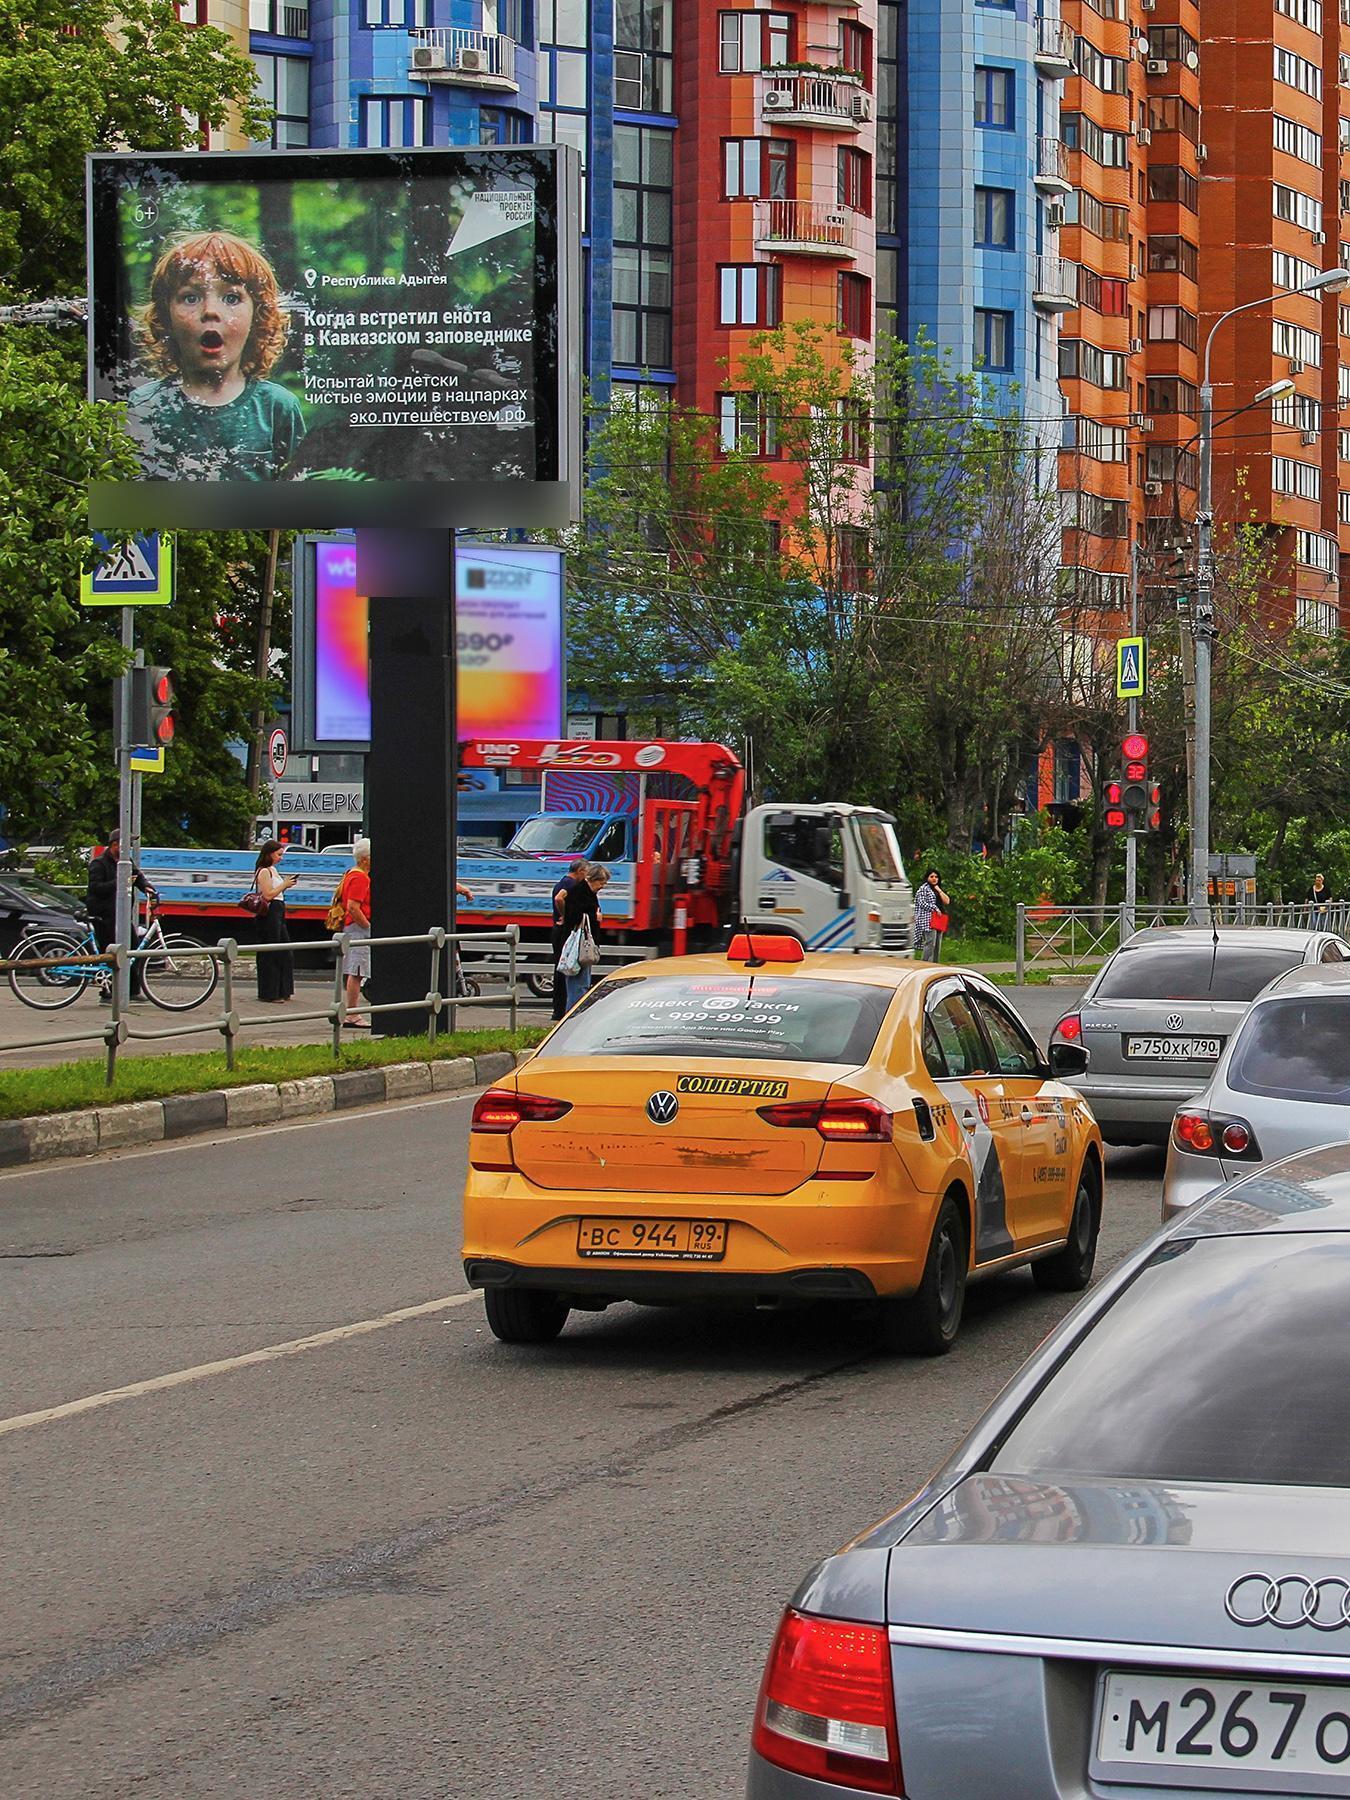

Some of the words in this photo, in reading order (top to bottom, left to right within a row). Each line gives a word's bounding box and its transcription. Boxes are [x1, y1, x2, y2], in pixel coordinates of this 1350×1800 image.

[474, 192, 533, 202] НАЦИОНАЛЬНЫЕ
[135, 204, 155, 222] 6+
[499, 202, 533, 211] ПРОЕКТЫ
[505, 211, 533, 220] РОССИИ
[322, 275, 396, 288] Республика
[398, 273, 448, 287] Адыгея
[304, 310, 355, 328] Когда
[360, 310, 438, 328] встретил
[443, 309, 492, 325] енота
[304, 333, 315, 346] в
[319, 329, 420, 346] Кавказском
[425, 327, 533, 346] заповеднике
[305, 374, 374, 389] Испытай
[378, 374, 459, 389] по-детски
[304, 391, 362, 405] чистые
[366, 389, 427, 405] эмоции
[432, 391, 441, 403] в
[445, 389, 528, 405] нацпарках
[350, 406, 527, 425] эко.путешествуем.рф
[280, 792, 364, 812] БАКЕРК
[628, 1000, 699, 1009] Яндекс
[744, 1000, 800, 1012] Такси
[669, 1011, 782, 1024] 999-99-99
[1193, 1040, 1216, 1053] 790
[677, 1076, 787, 1098] СОЛЛЕРТИЯ
[632, 1223, 677, 1247] 944
[693, 1224, 717, 1242] 99
[694, 1242, 712, 1250] RUS
